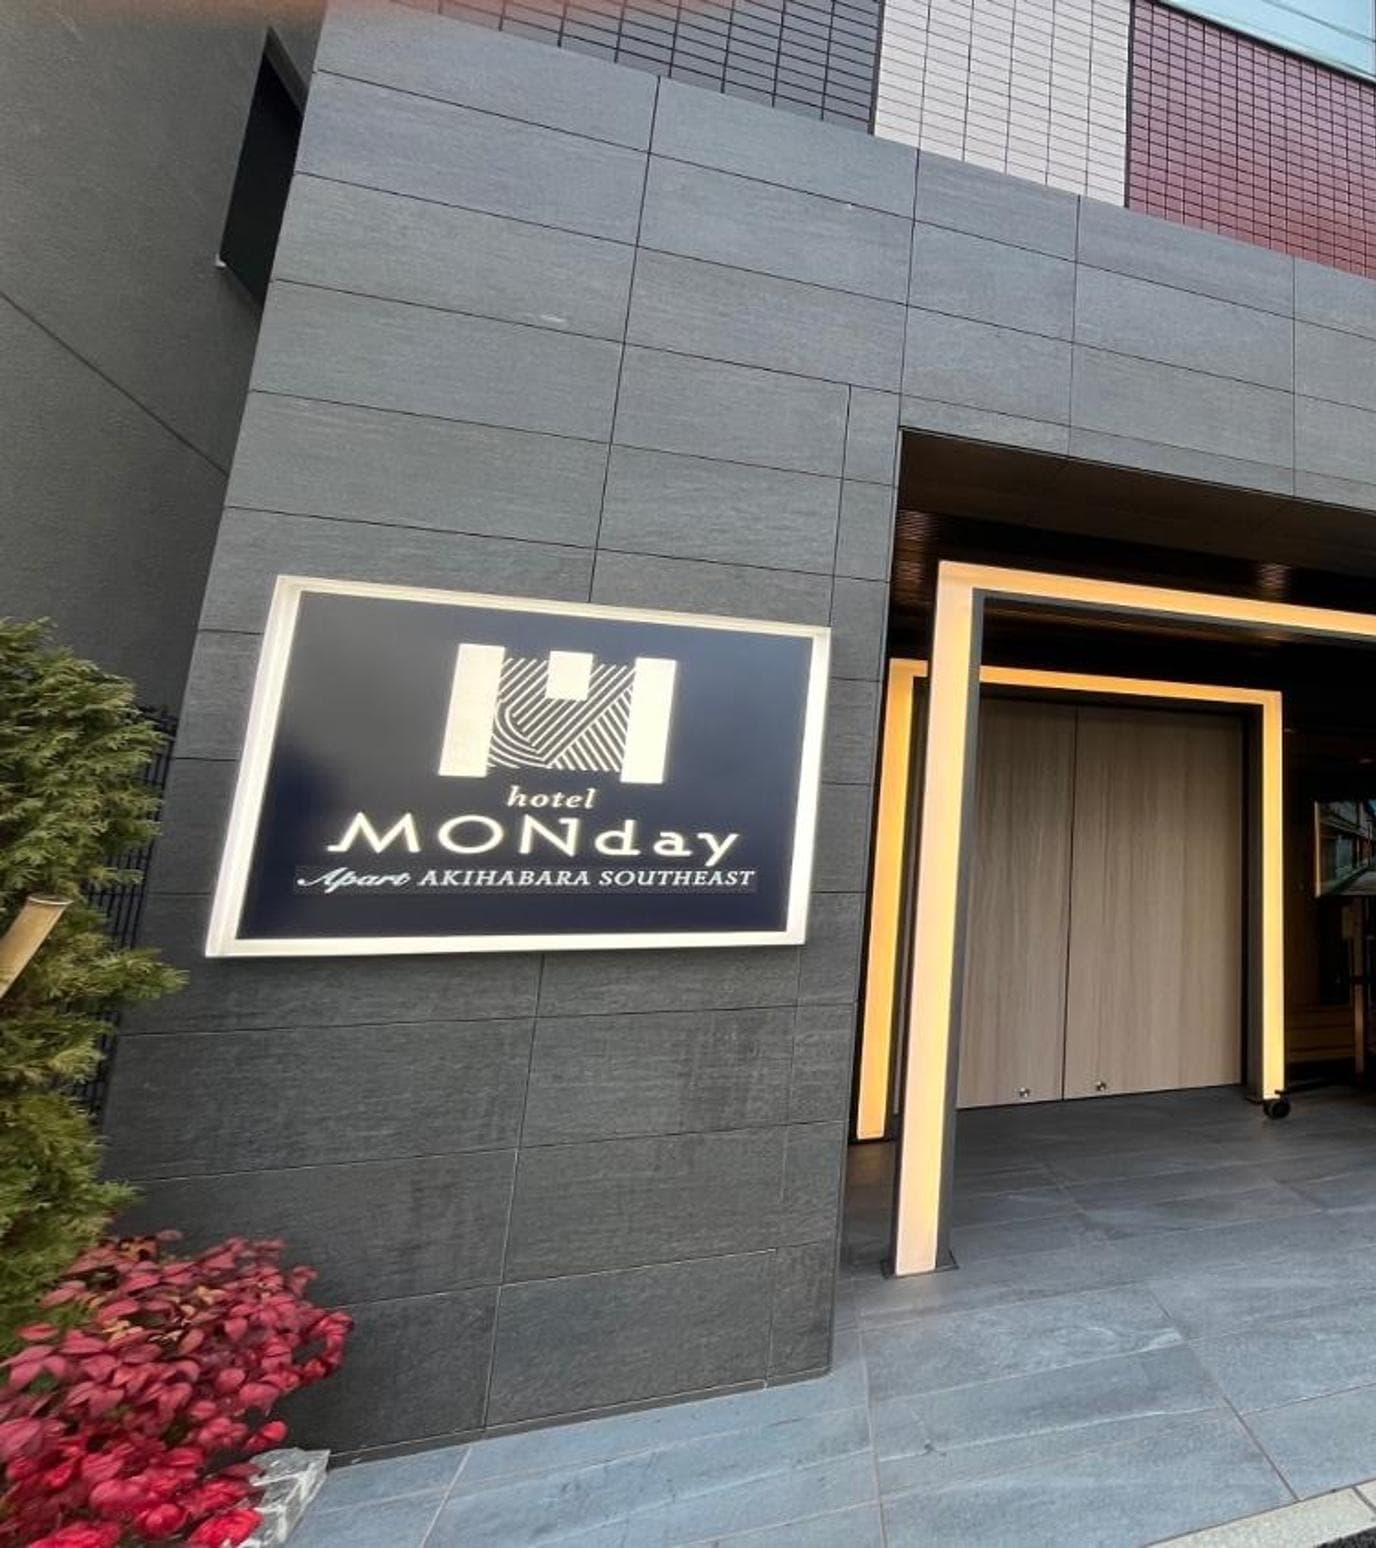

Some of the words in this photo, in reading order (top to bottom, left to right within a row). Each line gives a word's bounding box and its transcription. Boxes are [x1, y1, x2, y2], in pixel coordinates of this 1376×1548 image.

[507, 785, 597, 809] hotel
[327, 812, 740, 867] MONday
[297, 866, 411, 894] Apart
[417, 870, 591, 887] AKIHABARA
[598, 870, 756, 887] SOUTHEAST
